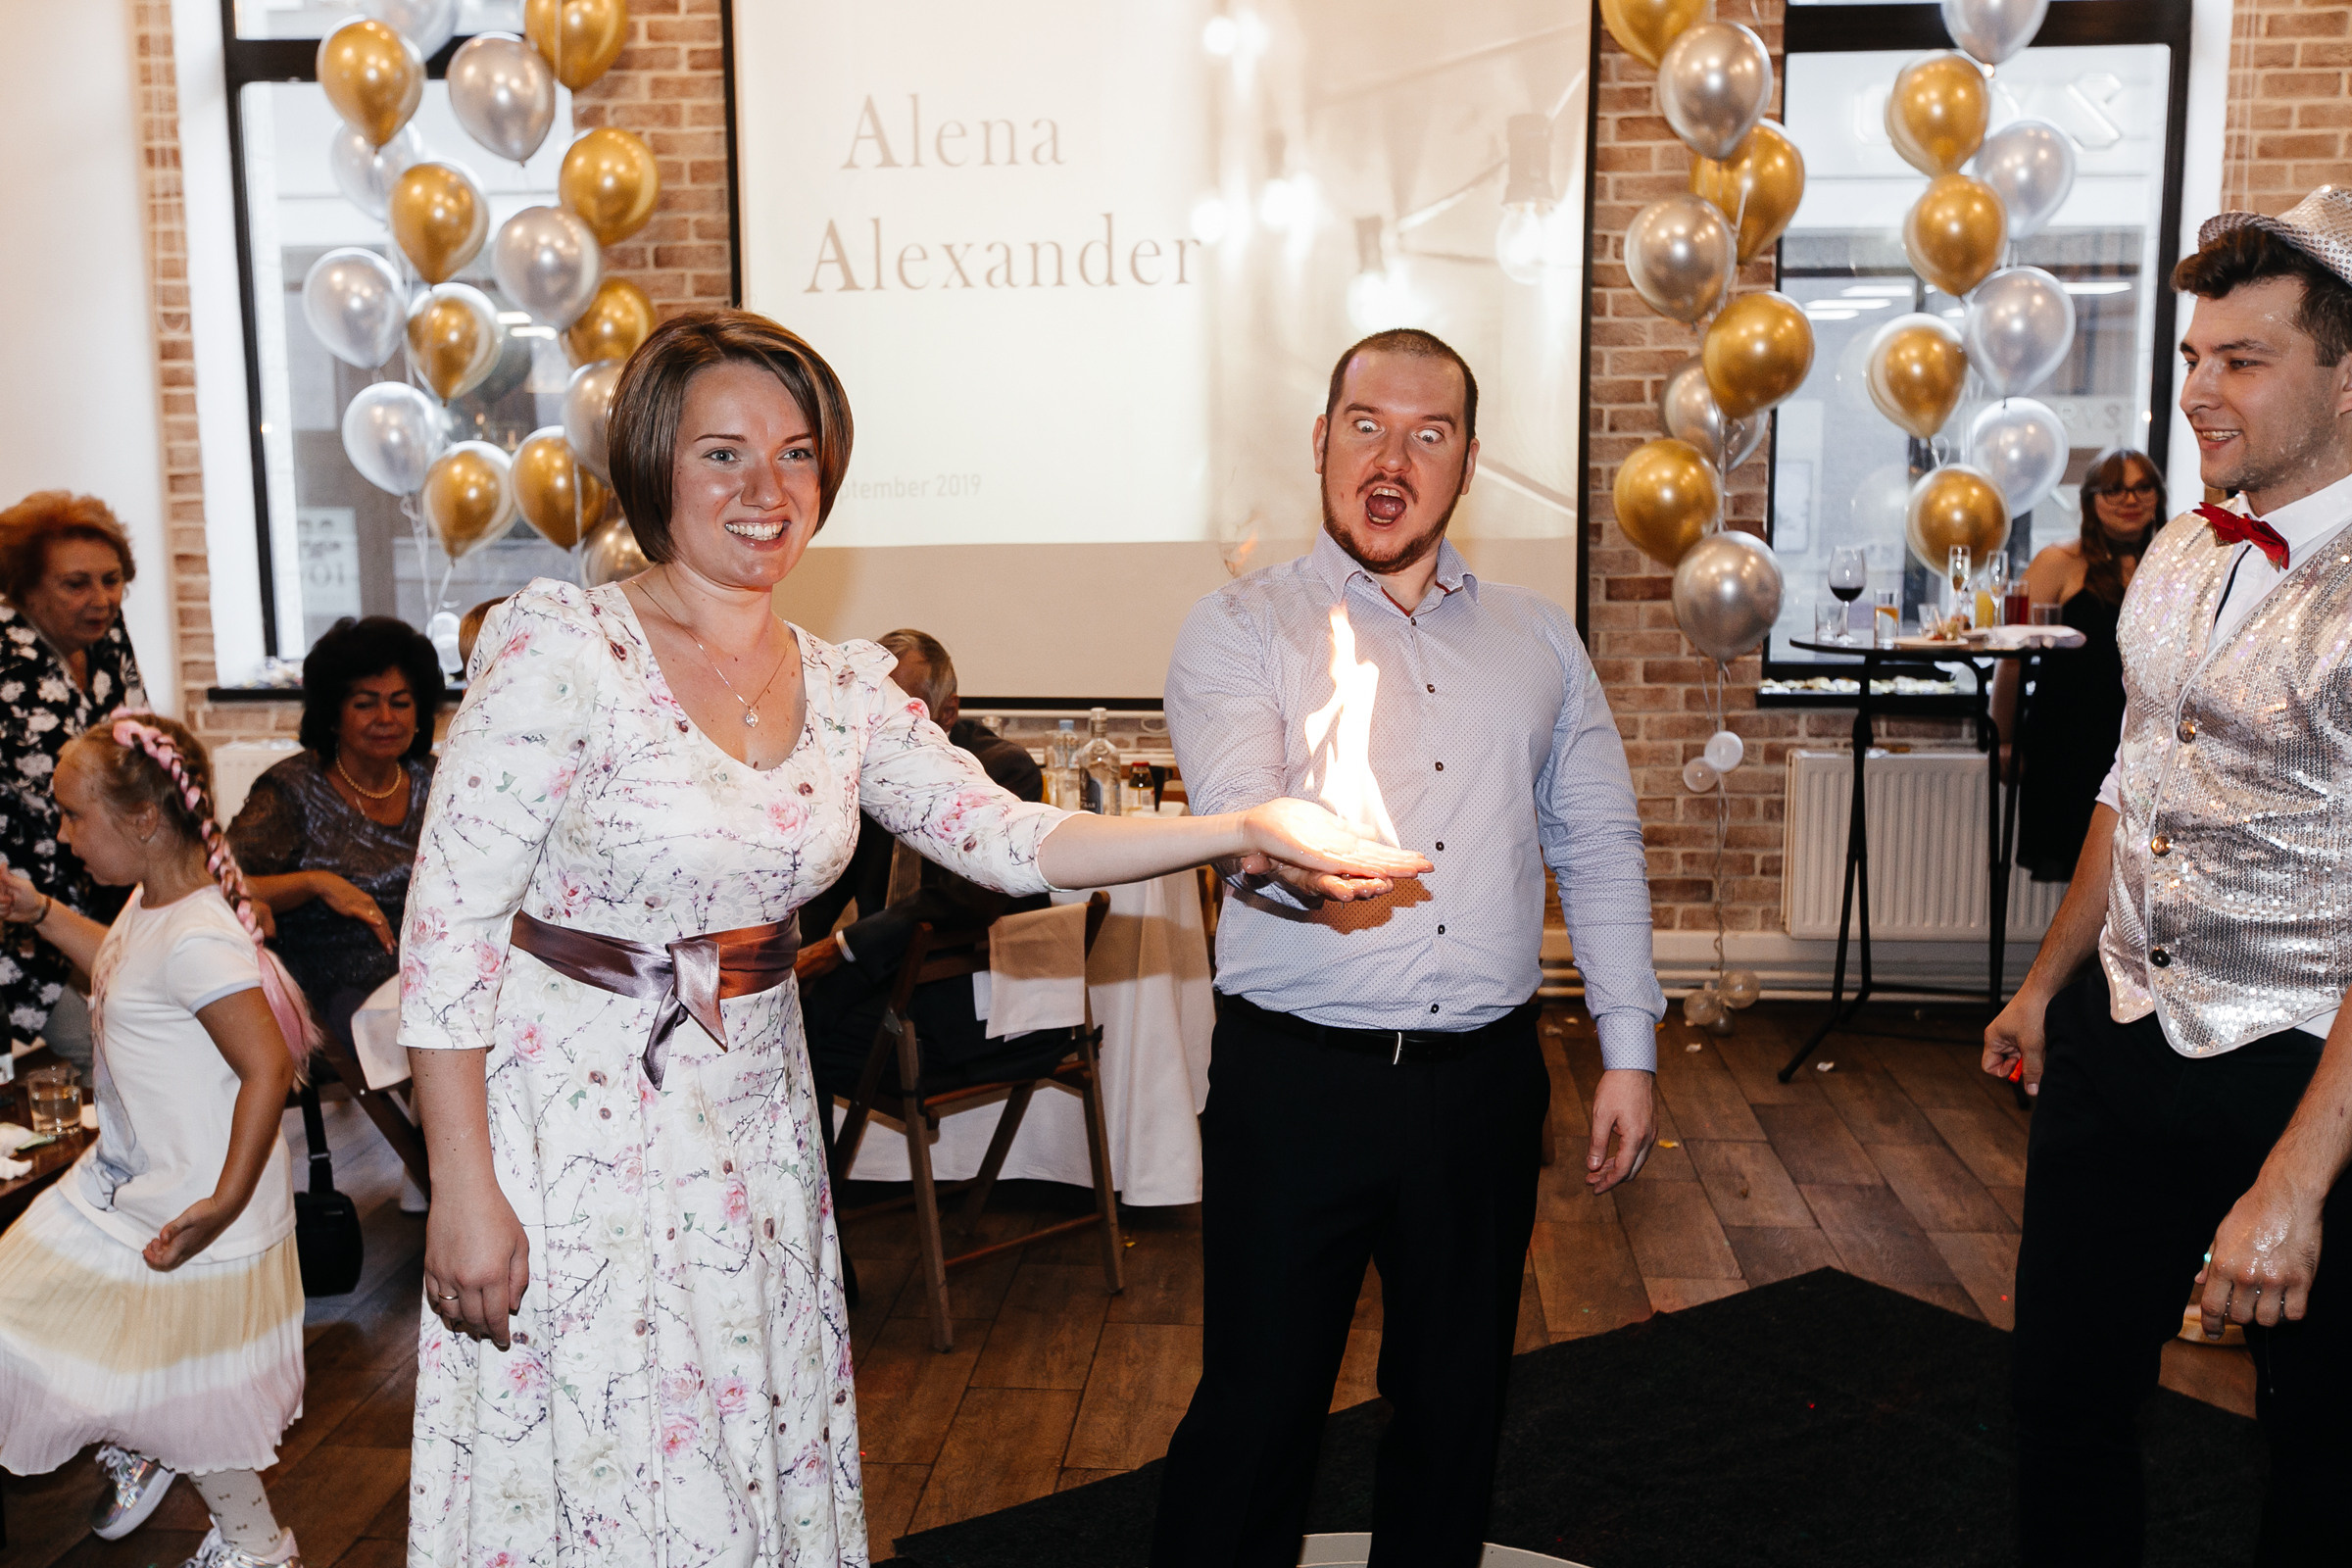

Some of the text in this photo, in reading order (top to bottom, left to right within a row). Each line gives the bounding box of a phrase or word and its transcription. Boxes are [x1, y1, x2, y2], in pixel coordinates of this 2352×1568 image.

[840, 92, 1068, 170] Alena
[802, 212, 1203, 293] Alexander
[838, 473, 983, 504] ptember 2019
